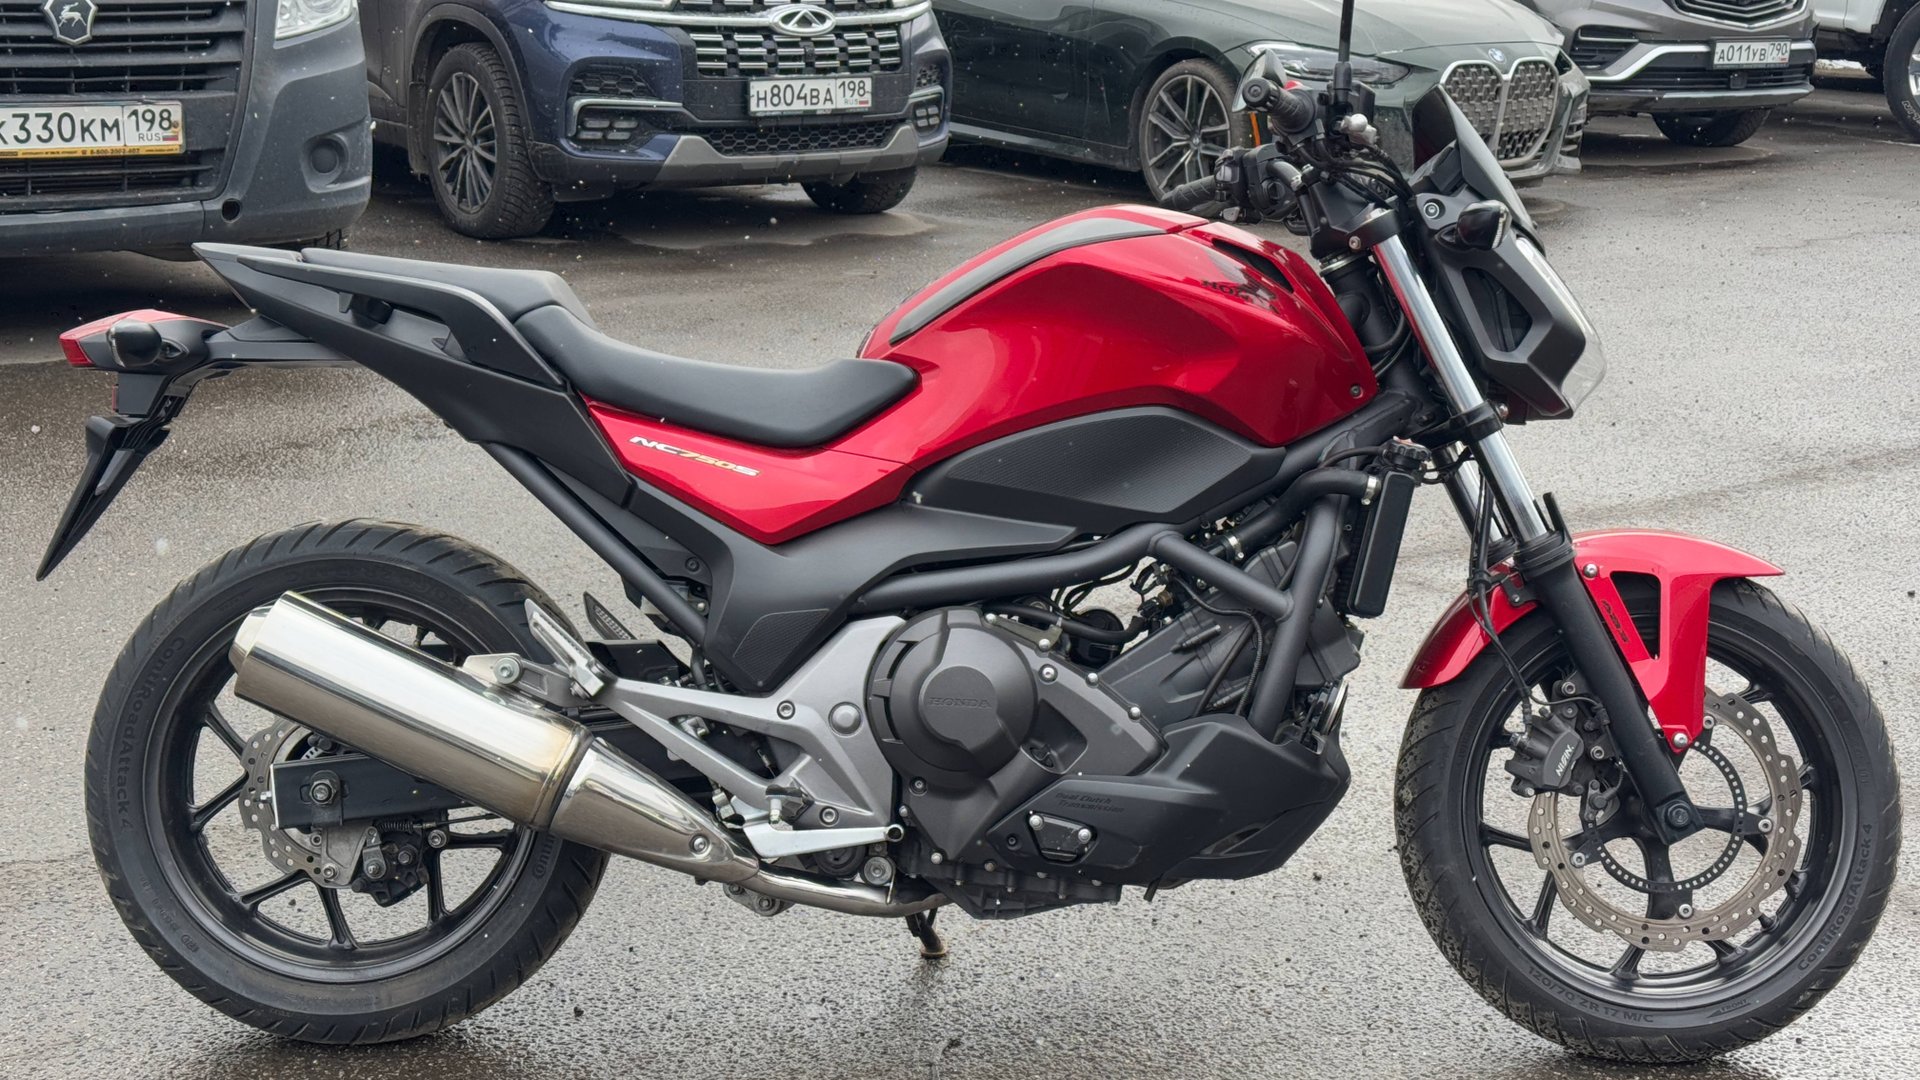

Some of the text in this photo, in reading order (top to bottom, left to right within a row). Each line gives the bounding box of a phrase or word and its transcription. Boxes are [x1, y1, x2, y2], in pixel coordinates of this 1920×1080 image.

[1769, 43, 1787, 56] 790
[756, 80, 866, 108] Н804ВА 198
[127, 108, 172, 132] 198
[138, 133, 161, 142] RUS
[629, 436, 760, 477] NC750S
[928, 697, 993, 709] HONDA
[117, 636, 185, 815] ContiRoadAttack
[1055, 792, 1112, 804] Dual Clutch
[1058, 799, 1125, 813] Transmission
[1797, 838, 1872, 971] ContiRoadAttack
[1863, 823, 1873, 834] 4
[1528, 966, 1654, 1023] 120/70 ZR 17 M/C
